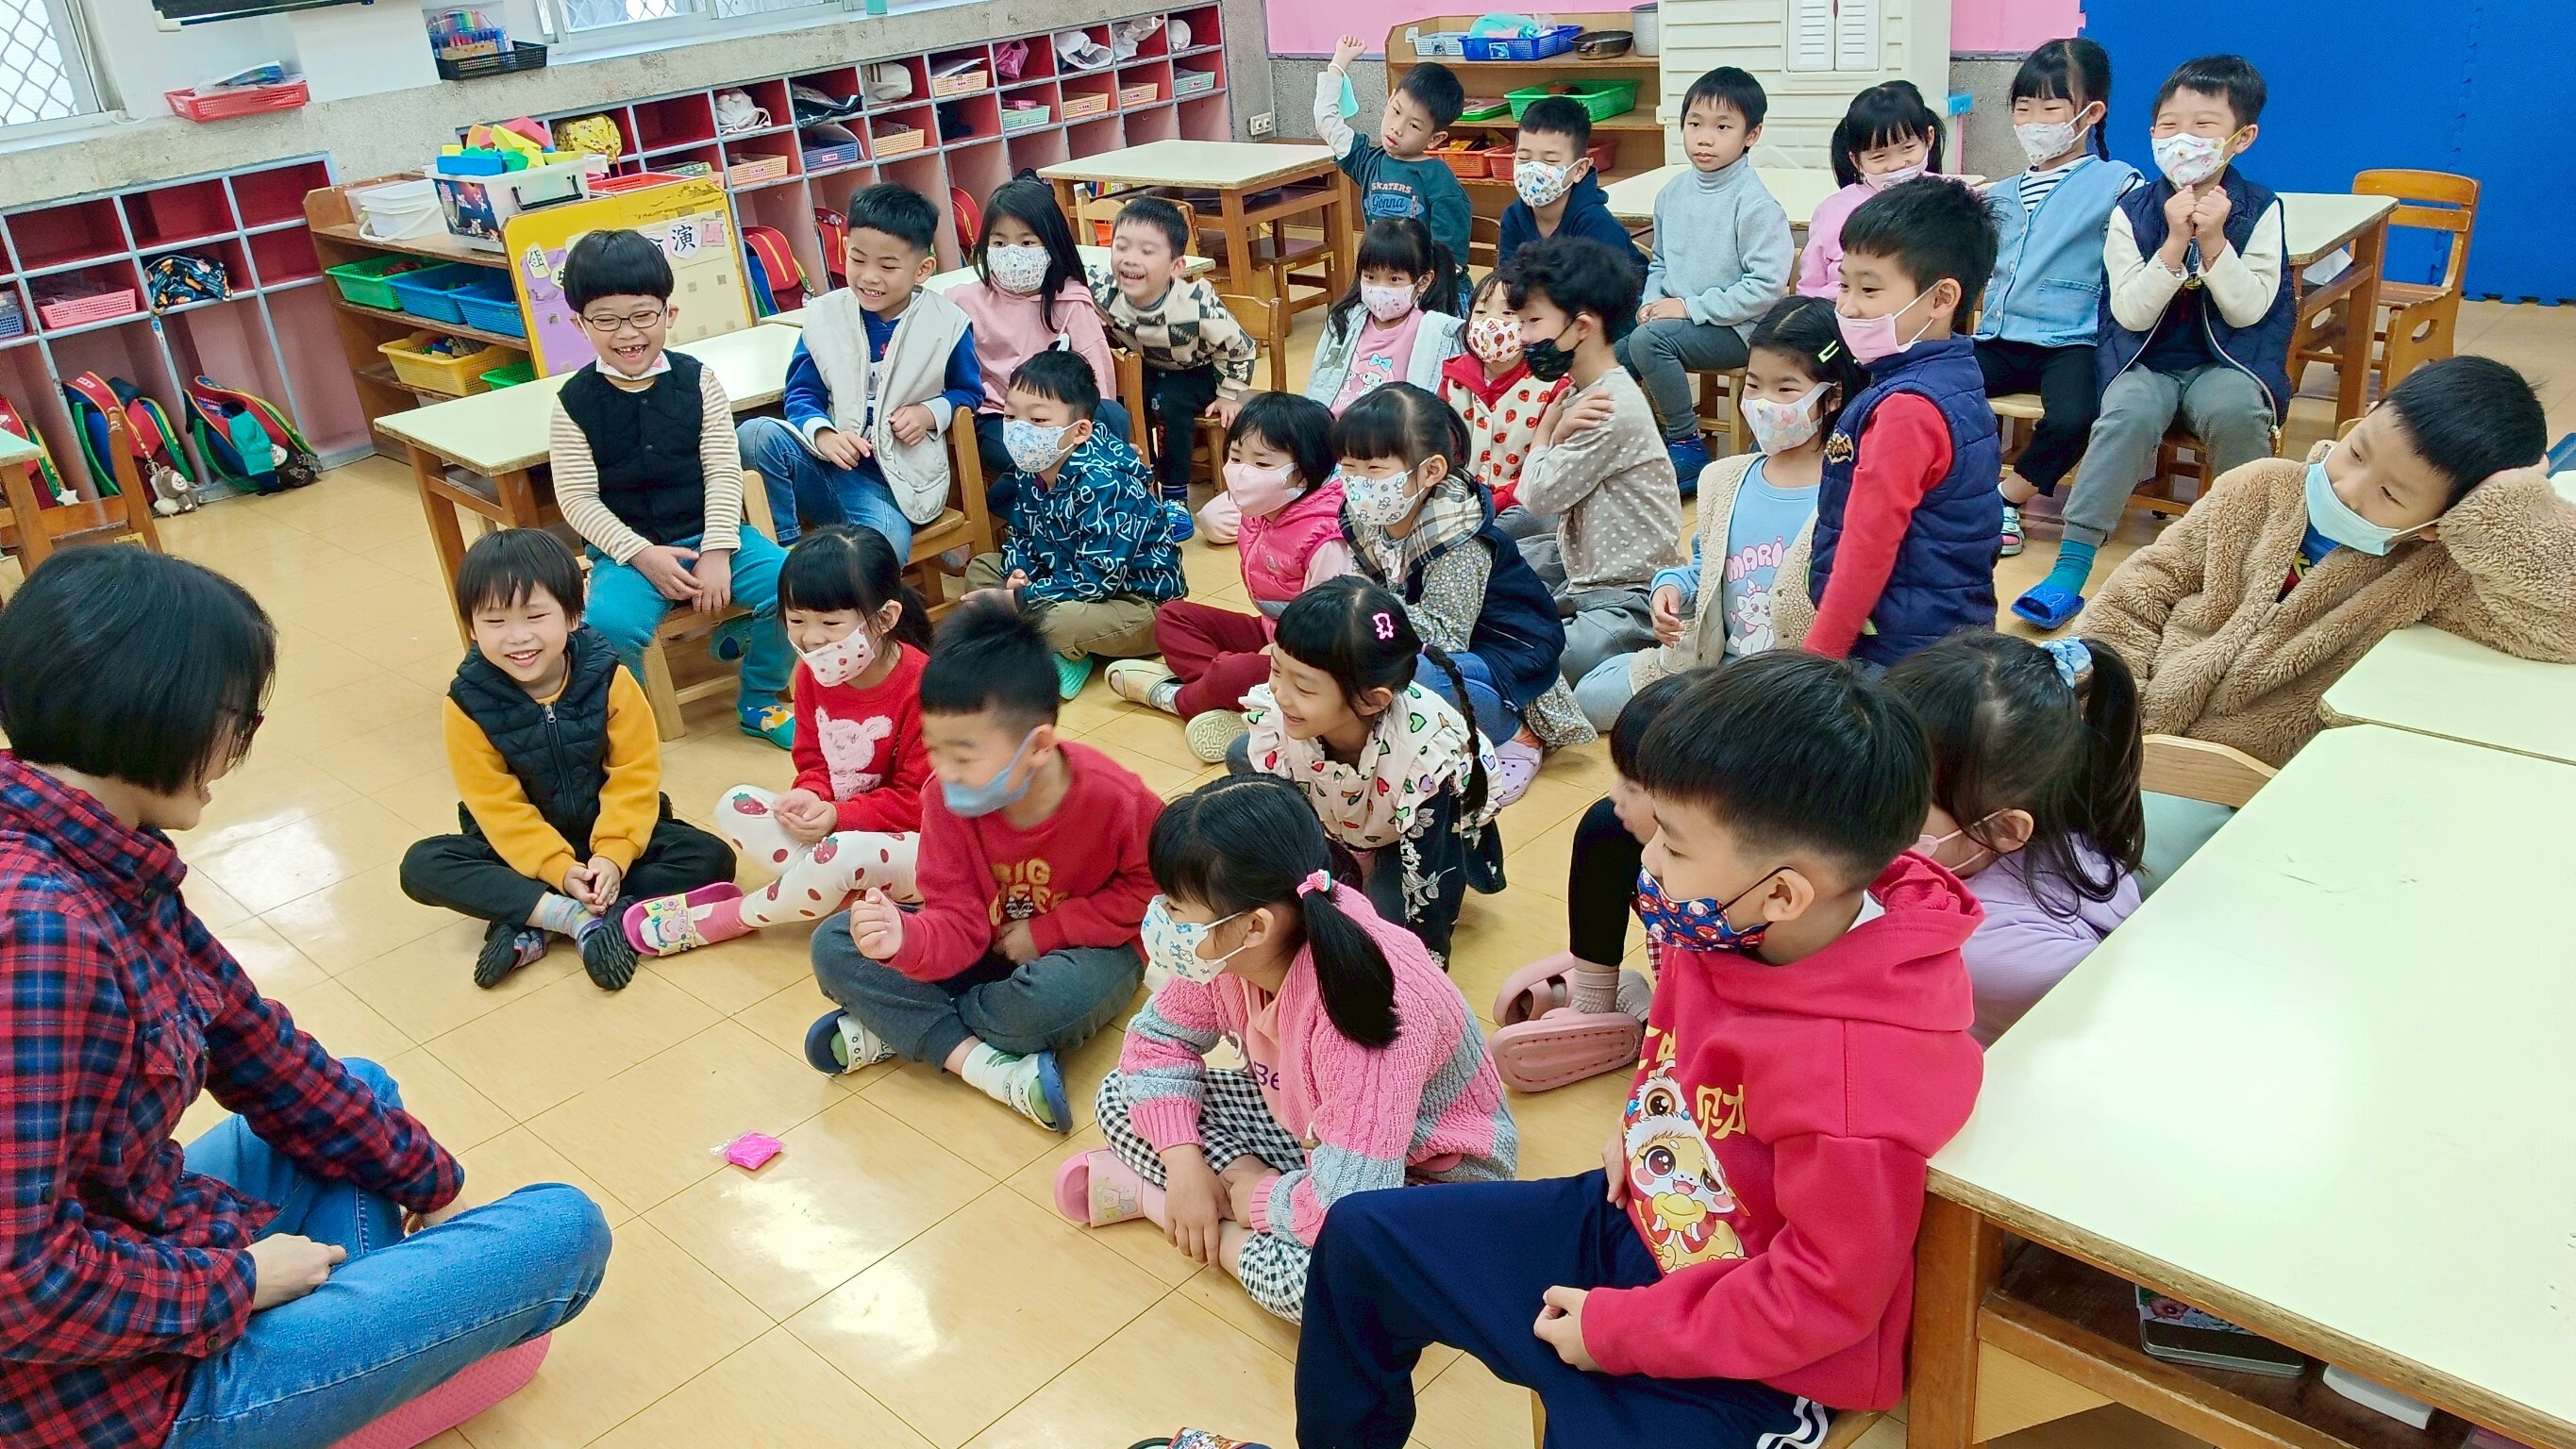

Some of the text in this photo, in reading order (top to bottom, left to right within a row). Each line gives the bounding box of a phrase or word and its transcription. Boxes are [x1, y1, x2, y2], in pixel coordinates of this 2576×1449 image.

[1371, 181, 1413, 194] SKATERS
[1372, 194, 1407, 213] Gonna
[672, 225, 696, 252] 演
[1725, 535, 1789, 583] MARI
